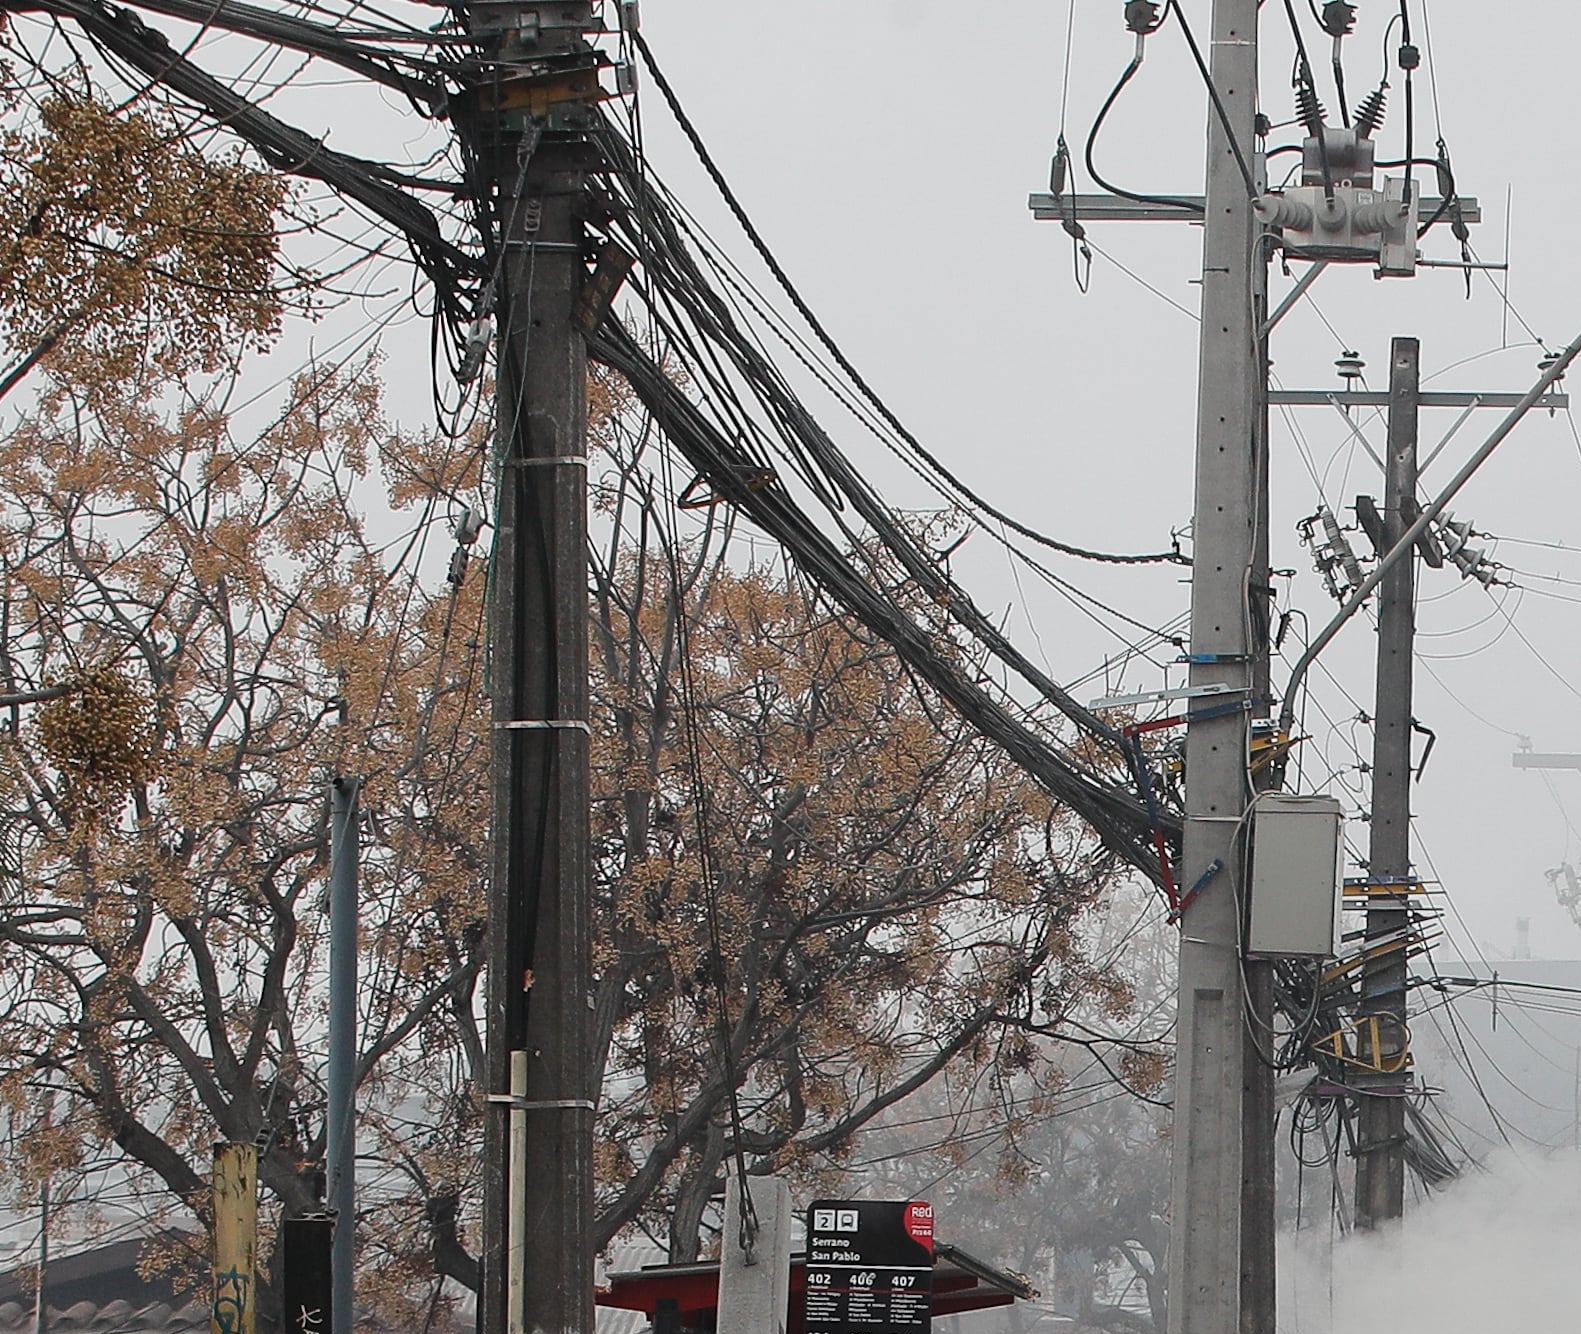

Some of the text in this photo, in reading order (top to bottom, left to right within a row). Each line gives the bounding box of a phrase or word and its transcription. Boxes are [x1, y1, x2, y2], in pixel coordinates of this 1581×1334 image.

[911, 1206, 932, 1218] Red
[820, 1216, 829, 1229] 2
[812, 1237, 851, 1248] Serrano
[811, 1250, 861, 1262] San Pablo
[807, 1273, 832, 1285] 402
[849, 1273, 874, 1286] 406
[891, 1276, 915, 1287] 407
